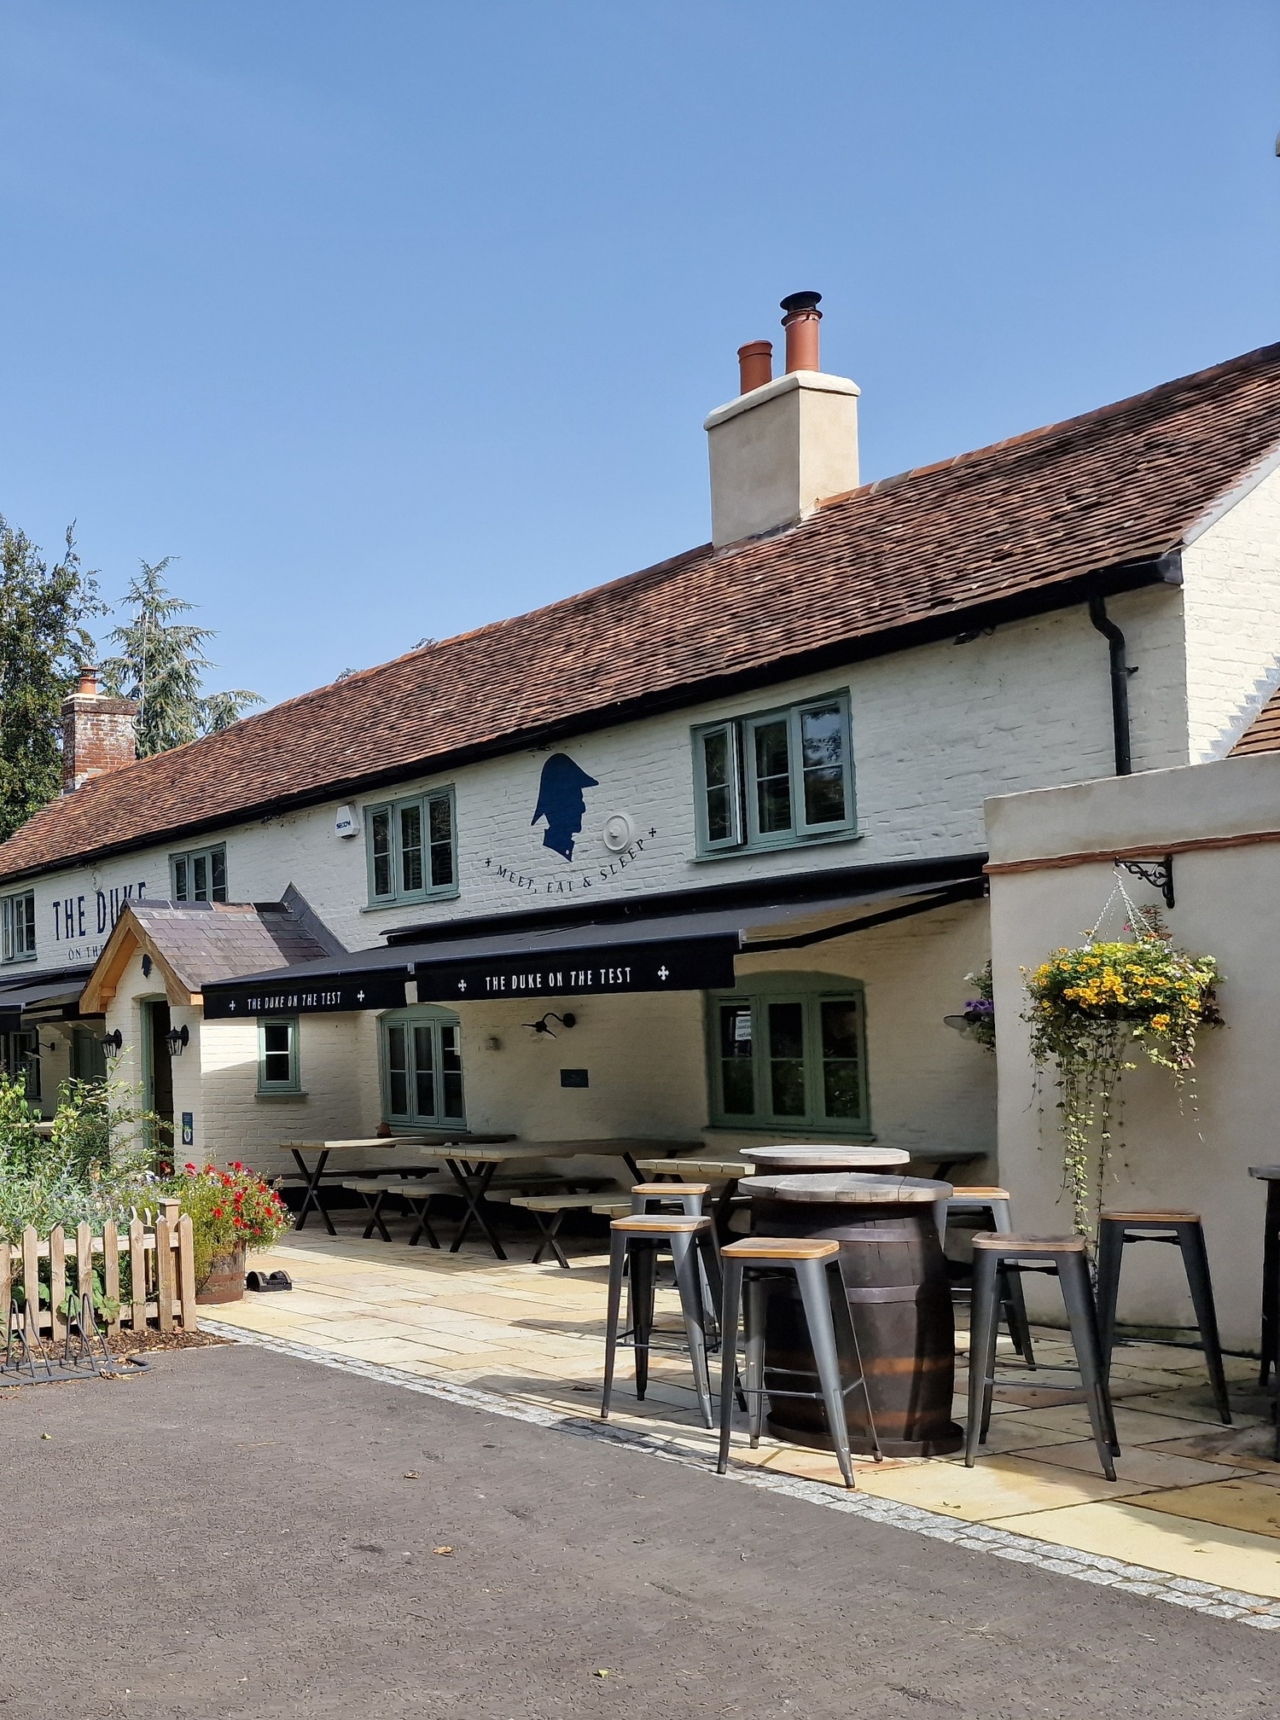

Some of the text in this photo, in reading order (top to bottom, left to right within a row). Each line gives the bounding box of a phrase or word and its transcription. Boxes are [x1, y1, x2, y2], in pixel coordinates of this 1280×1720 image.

[496, 839, 644, 894] MEET, EAT & SLEEP
[53, 882, 145, 940] THE DU
[68, 947, 81, 961] ON
[485, 967, 632, 992] THE DUKE ON THE TEST
[247, 991, 342, 1011] THE DUKE ON THE TEST
